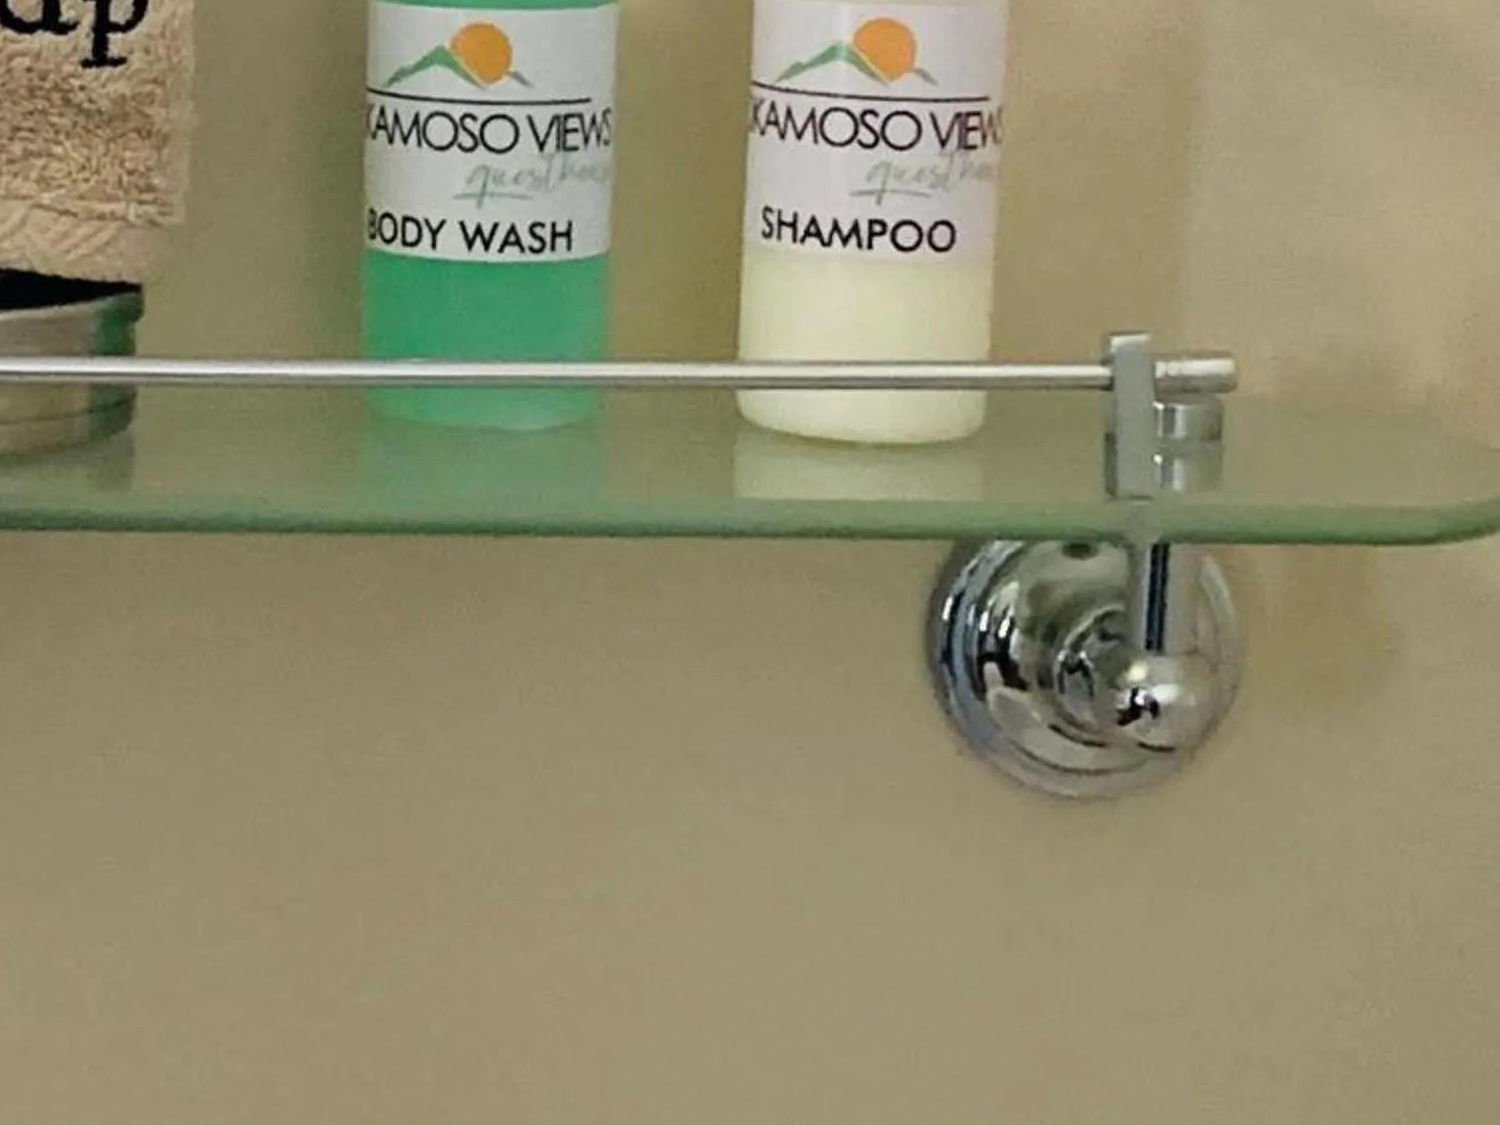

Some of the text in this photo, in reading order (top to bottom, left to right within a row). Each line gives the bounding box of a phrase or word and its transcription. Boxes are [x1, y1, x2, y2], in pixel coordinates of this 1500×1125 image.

[526, 106, 613, 153] VIEWS
[367, 207, 574, 255] BODY WASH
[760, 205, 957, 253] SHAMPOO
